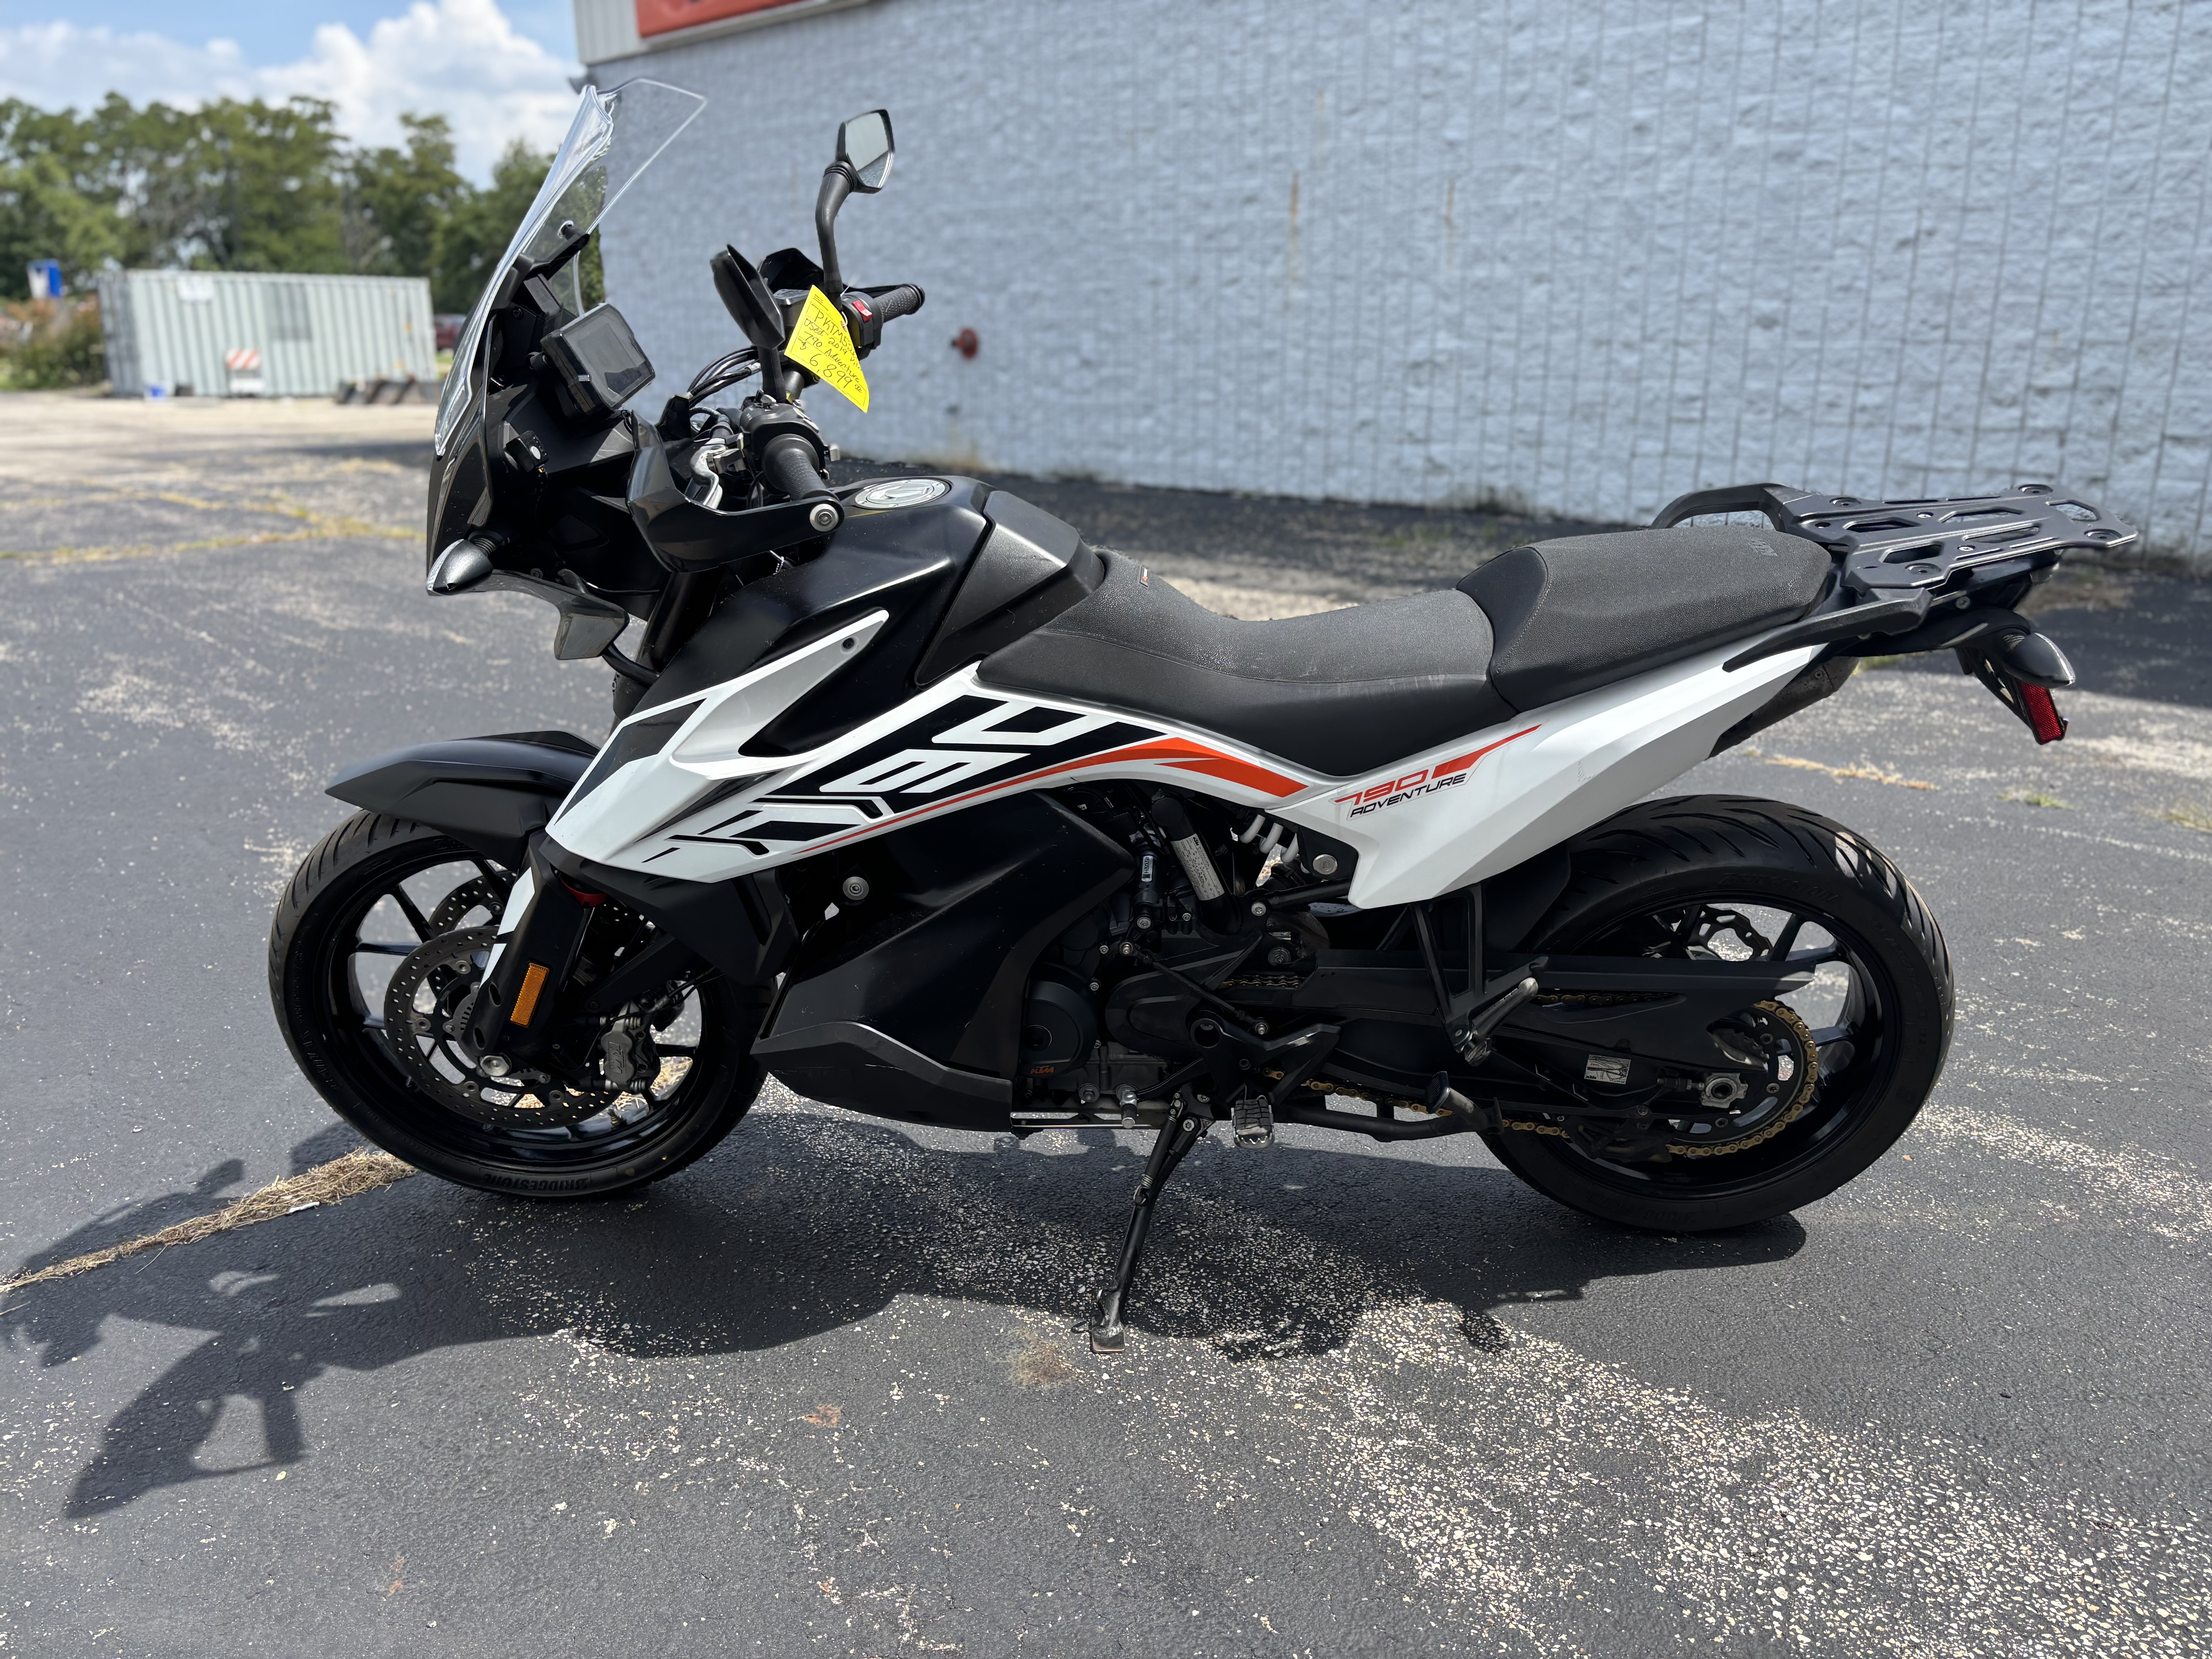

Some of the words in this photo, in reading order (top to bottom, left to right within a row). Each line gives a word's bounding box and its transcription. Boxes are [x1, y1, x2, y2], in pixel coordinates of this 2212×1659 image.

[804, 331, 823, 347] 790
[824, 349, 859, 383] Adventure
[828, 337, 848, 355] 2019
[809, 354, 853, 388] 6,899
[1334, 769, 1429, 805] 790
[1350, 773, 1467, 817] ADVENTURE
[1030, 1066, 1054, 1074] KTM
